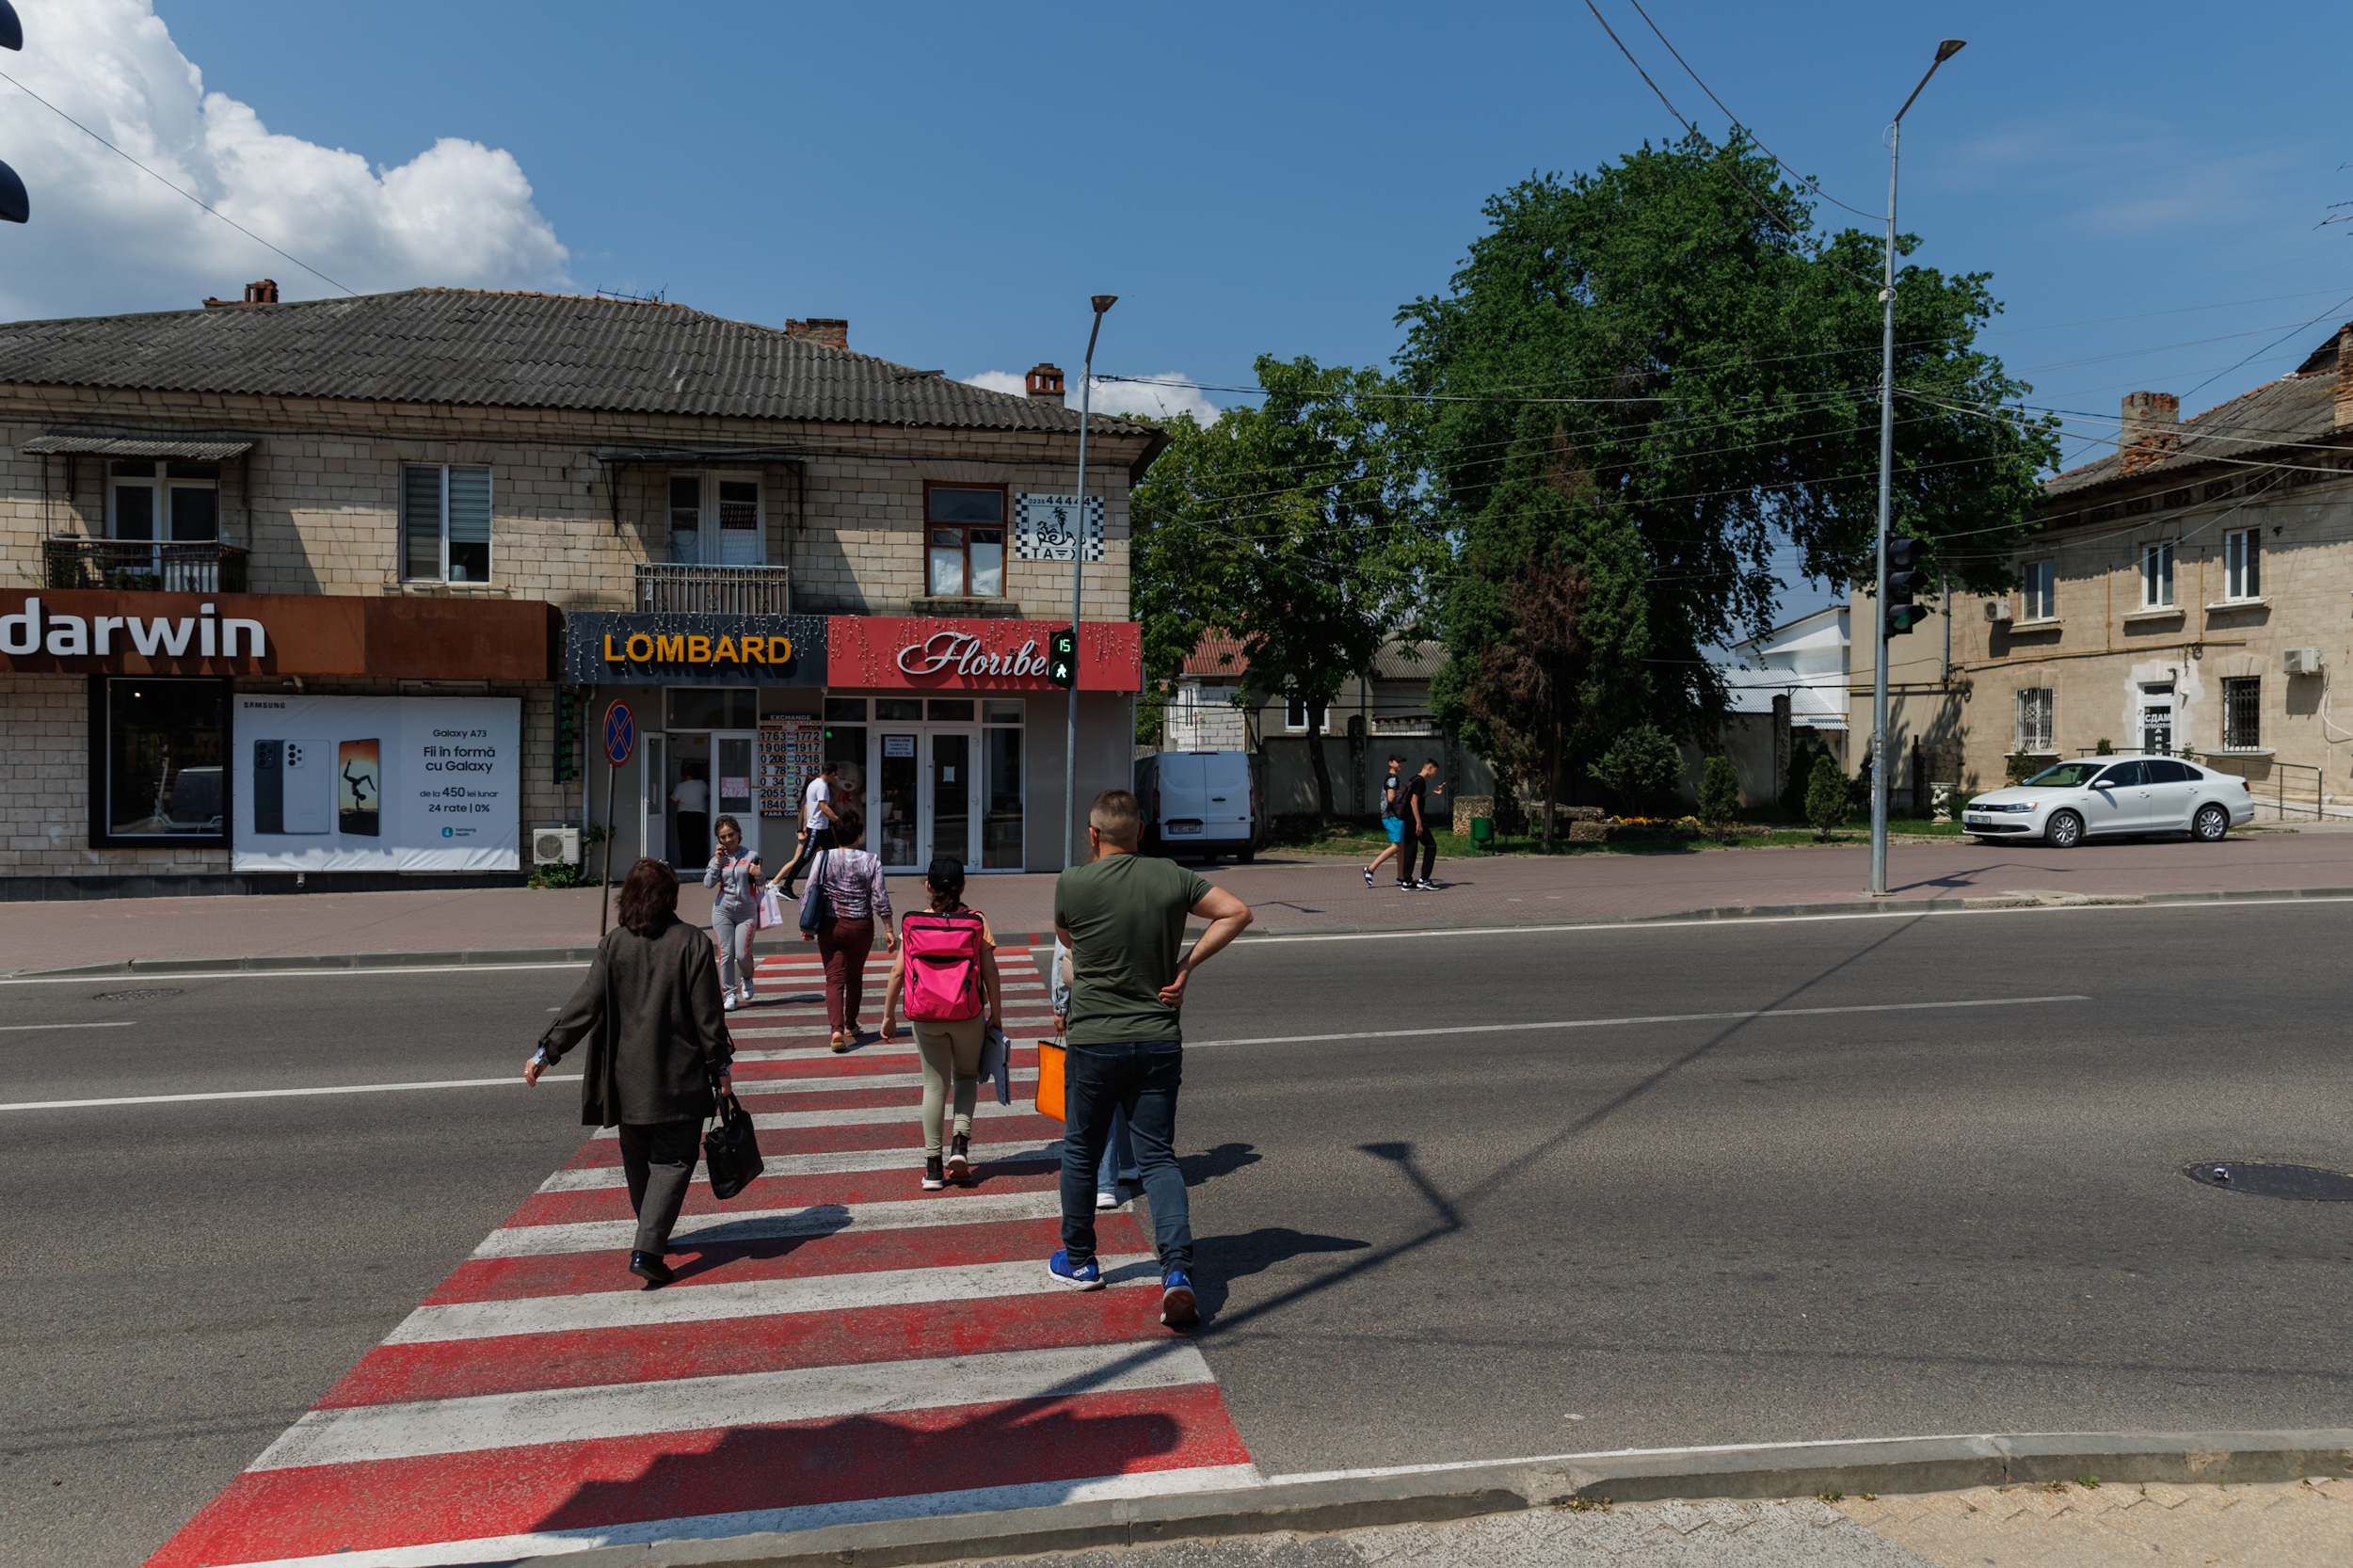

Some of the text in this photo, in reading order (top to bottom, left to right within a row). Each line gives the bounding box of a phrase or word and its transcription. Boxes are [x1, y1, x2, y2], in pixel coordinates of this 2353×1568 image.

[0, 597, 266, 658] darwin
[604, 633, 792, 664] LOMBARD
[1059, 639, 1071, 652] 15
[896, 631, 1050, 677] Floribe
[2145, 713, 2171, 724] СДАМ
[433, 729, 487, 739] Galaxy A73
[760, 732, 786, 741] 1763
[795, 732, 820, 741] 1772
[424, 746, 496, 758] Fii în formă
[760, 743, 787, 752] 1908
[794, 743, 820, 752] 1917
[795, 754, 820, 763] 0218
[426, 761, 493, 774] cu Galaxy
[442, 787, 465, 798] 450
[722, 788, 749, 797] 24/24
[760, 789, 786, 798] 2055
[428, 804, 441, 812] 24
[444, 804, 467, 812] rate
[475, 804, 490, 812] 0%
[761, 800, 786, 809] 1840
[1072, 1266, 1089, 1278] HOKA
